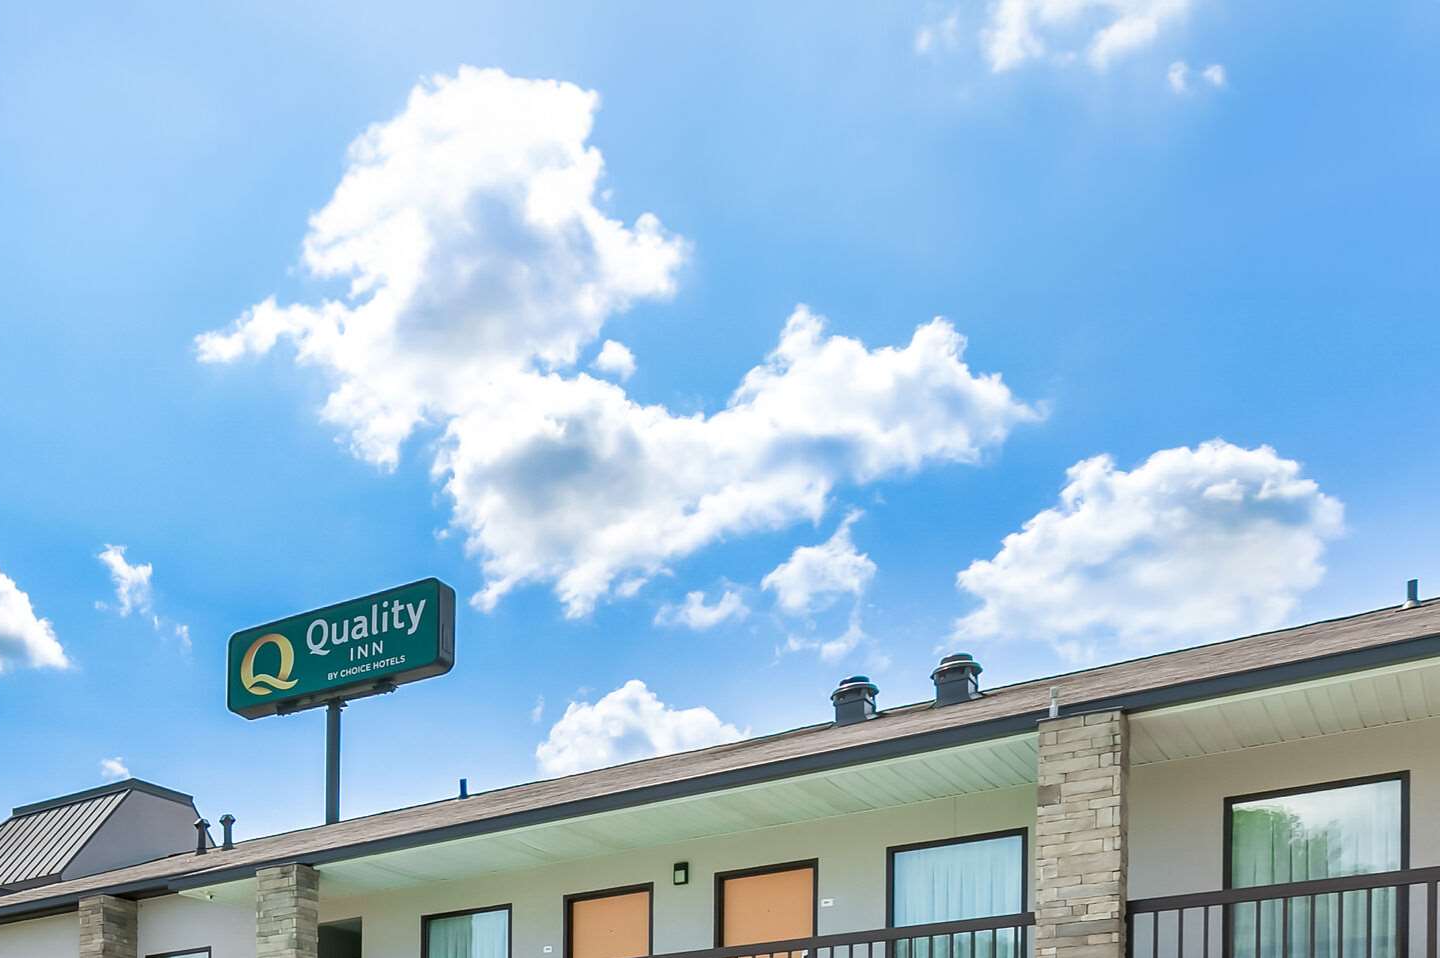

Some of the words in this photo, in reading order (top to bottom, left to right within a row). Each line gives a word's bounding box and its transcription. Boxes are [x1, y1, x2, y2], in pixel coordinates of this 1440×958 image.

[306, 599, 426, 655] Quality
[240, 633, 299, 695] Q
[327, 671, 338, 681] BY
[340, 663, 371, 678] CHOICE
[373, 654, 406, 670] HOTELS
[349, 640, 384, 661] INN
